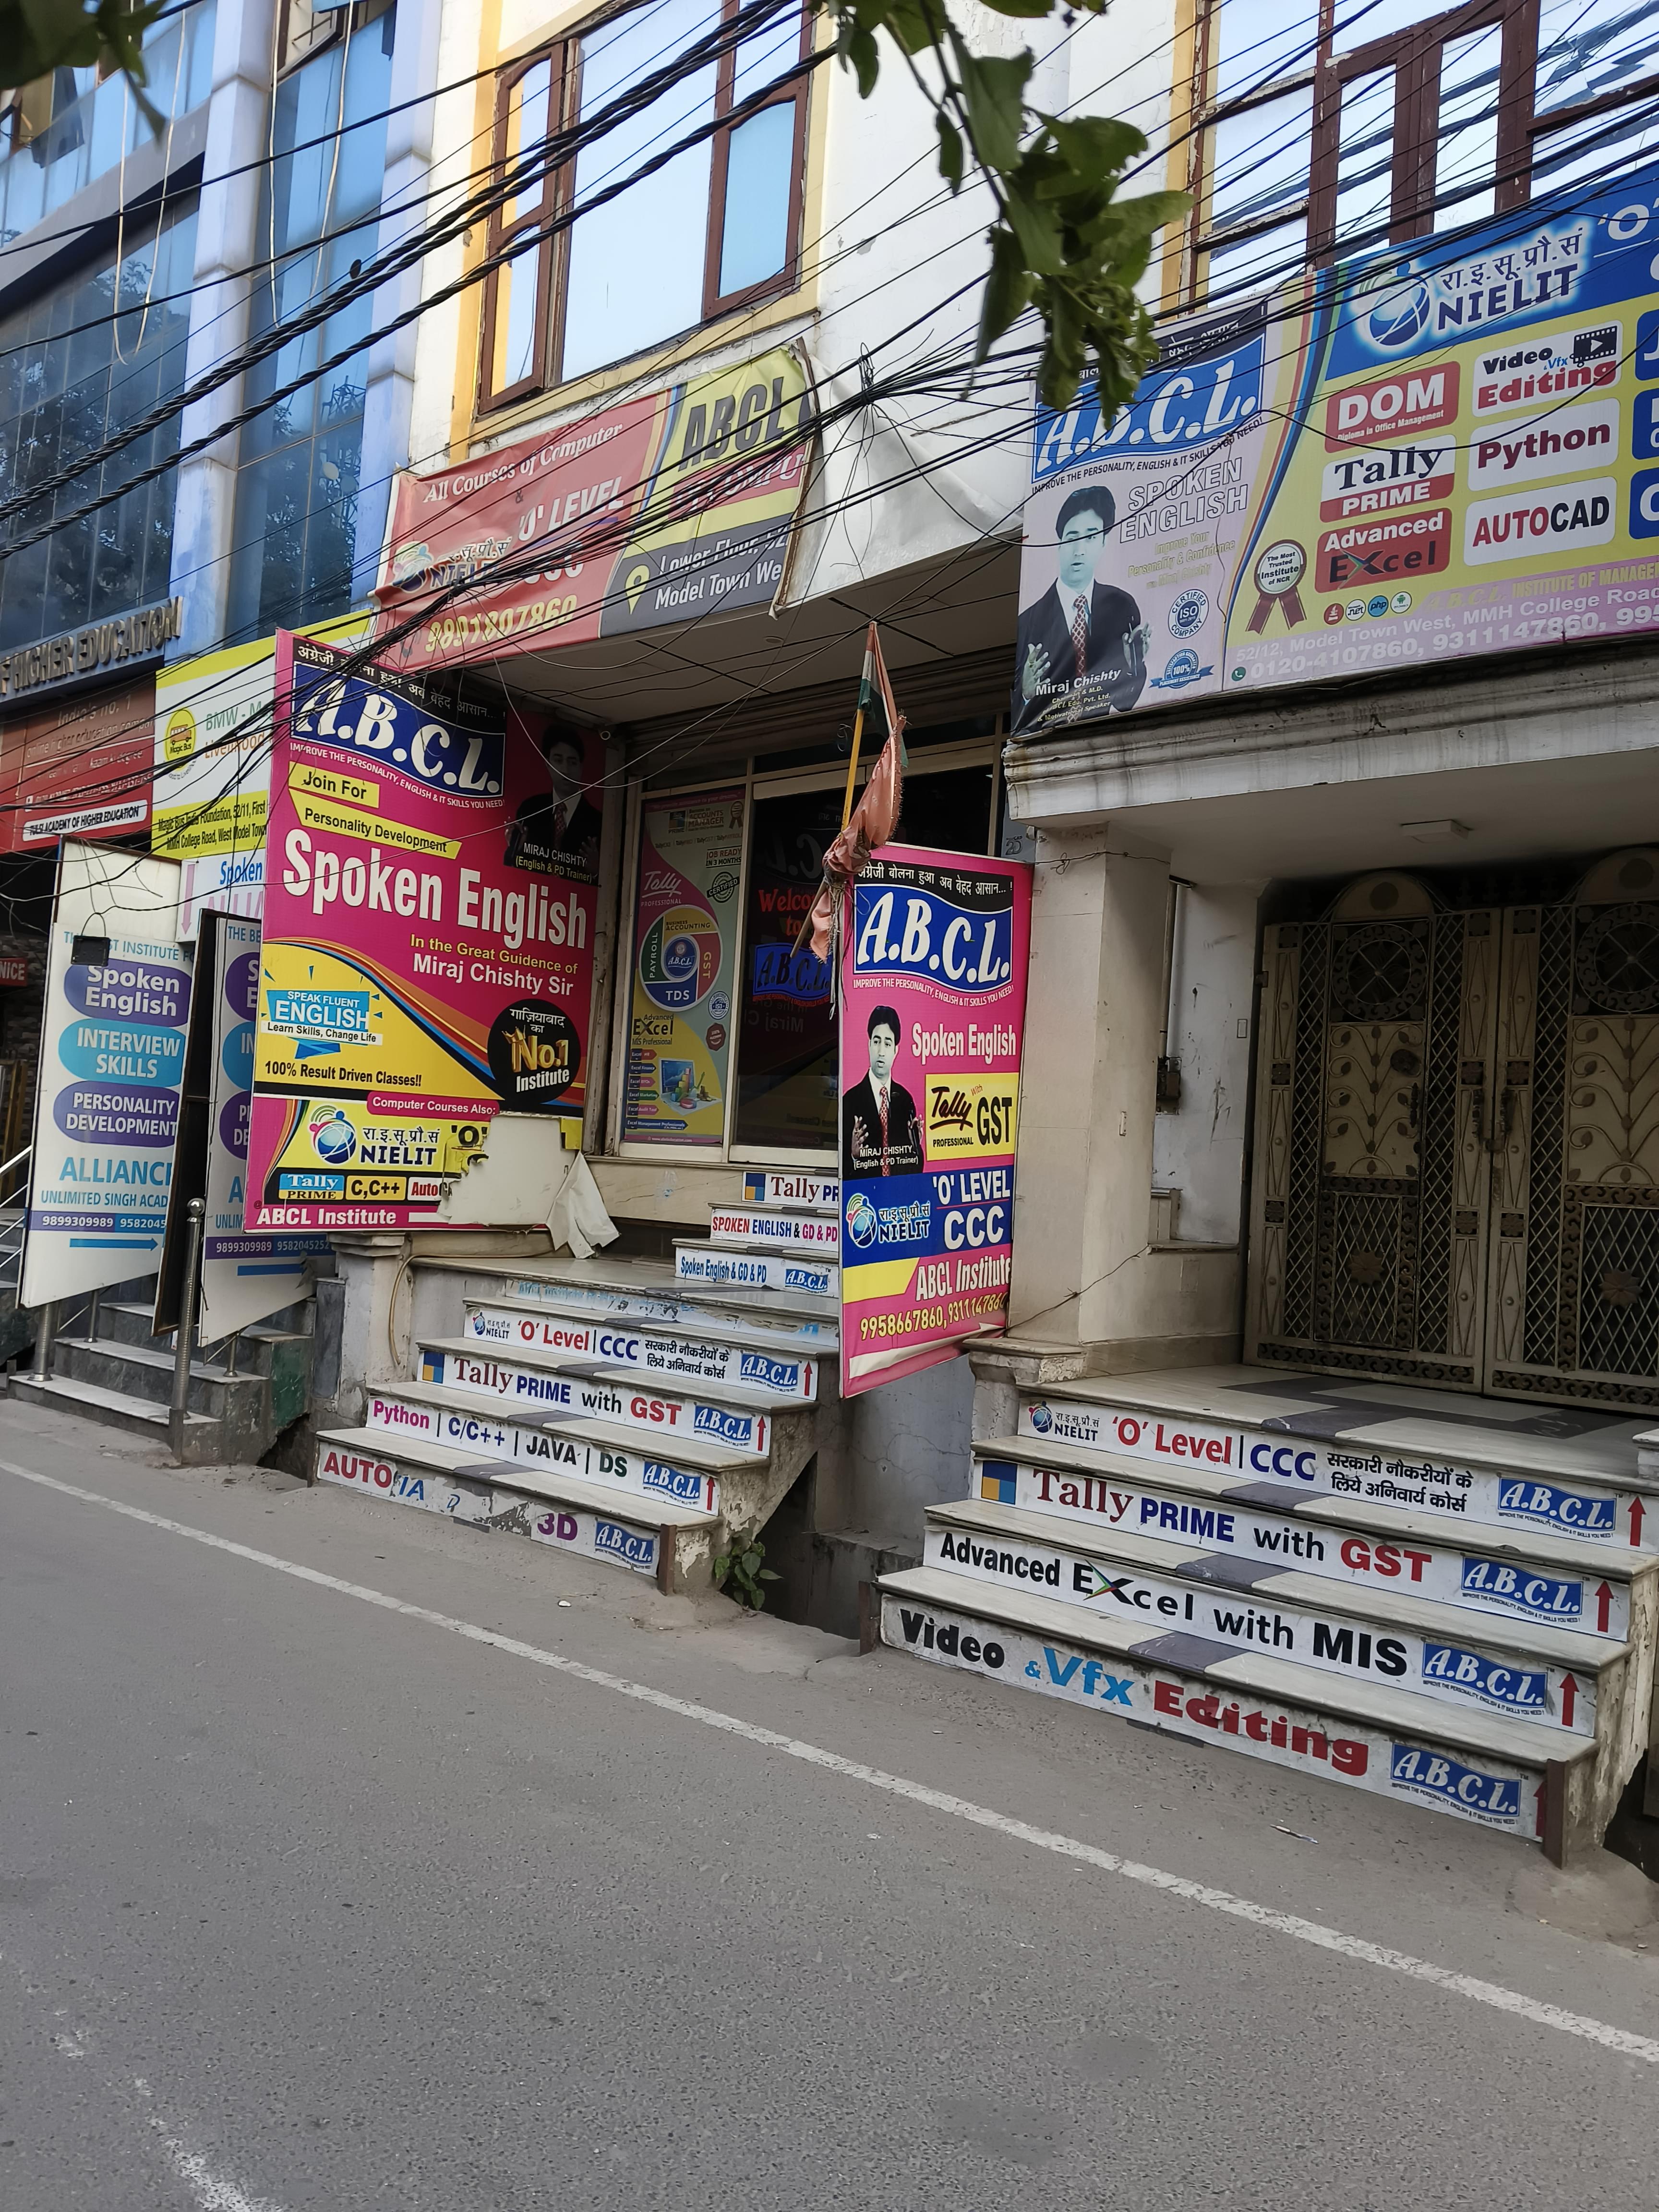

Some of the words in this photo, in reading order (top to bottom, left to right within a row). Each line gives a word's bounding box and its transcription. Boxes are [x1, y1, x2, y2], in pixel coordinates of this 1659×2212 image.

[1438, 264, 1577, 330] NIELIT
[1483, 347, 1553, 375] Video
[1478, 361, 1617, 410] Editing
[1338, 373, 1444, 430] DOM
[678, 376, 785, 472] ABCL
[1478, 423, 1610, 470] Python
[422, 481, 448, 503] All
[452, 461, 516, 495] Courses
[520, 457, 537, 476] of
[540, 421, 623, 466] Computer
[1334, 447, 1442, 490] Tally
[1129, 457, 1242, 511] SPOKEN
[1119, 483, 1248, 543] ENGLISH
[1343, 482, 1431, 516] PRIME
[1324, 512, 1443, 553] Advanced
[1472, 496, 1609, 547] AUTOCAD
[1261, 565, 1299, 579] Institute
[1269, 559, 1292, 568] Trusted
[654, 581, 704, 611] Model
[709, 569, 750, 597] Town
[1180, 605, 1197, 618] ISO
[1370, 601, 1386, 610] php
[11, 637, 74, 689] HIGHER
[76, 595, 183, 671] EDUCATION
[1236, 642, 1283, 662] 52/12,
[1290, 633, 1343, 653] Model
[1349, 625, 1397, 642] Town
[1404, 617, 1456, 633] West,
[1464, 604, 1512, 625] MMH
[1520, 596, 1599, 615] College
[1036, 680, 1069, 696] Miraj
[1074, 669, 1121, 688] Chishty
[341, 780, 367, 800] For
[44, 817, 71, 832] ACADEMY
[72, 817, 80, 828] OF
[80, 810, 103, 826] HIGHER
[104, 805, 139, 822] EDUCATION
[252, 800, 265, 816] First
[181, 832, 200, 849] College
[202, 830, 216, 845] Road,
[218, 827, 232, 839] West
[252, 824, 266, 836] Town
[304, 807, 373, 838] Personality
[374, 822, 447, 854] Development
[523, 842, 549, 858] MIRAJ
[220, 857, 262, 890] Spoken
[645, 870, 682, 897] Tally
[709, 878, 738, 896] CERTIFIED
[282, 828, 443, 922] Spoken
[457, 867, 588, 950] English
[641, 898, 682, 907] PROFESSIONAL
[665, 923, 711, 931] ACCOUNTING
[857, 891, 1010, 983] A.B.C.L.
[410, 935, 424, 948] In
[429, 939, 452, 952] the
[457, 943, 495, 960] Great
[499, 950, 561, 971] Guidence
[565, 963, 578, 974] of
[649, 933, 658, 978] PAYROLL
[703, 952, 711, 978] GST
[413, 953, 464, 983] Miraj
[470, 963, 543, 995] Chishty
[548, 976, 574, 996] Sir
[85, 986, 177, 1016] English
[288, 990, 321, 1003] SPEAK
[323, 996, 360, 1008] FLUENT
[665, 990, 689, 1001] TDS
[275, 999, 369, 1030] ENGLISH
[530, 1023, 545, 1034] का
[77, 1027, 180, 1057] INTERVIEW
[267, 1022, 294, 1033] Learn
[296, 1025, 323, 1037] Skills,
[325, 1029, 359, 1041] Change
[361, 1033, 376, 1042] Life
[912, 1022, 964, 1065] Spoken
[968, 1024, 1017, 1064] English
[96, 1054, 158, 1079] SKILLS
[265, 1060, 297, 1076] 100%
[300, 1064, 336, 1080] Result
[339, 1069, 373, 1083] Driven
[376, 1070, 422, 1087] Classes!!
[516, 1069, 570, 1093] Institute
[73, 1092, 175, 1116] PERSONALITY
[372, 1096, 424, 1110] Computer
[427, 1101, 468, 1114] Courses
[471, 1102, 496, 1115] Also:
[65, 1113, 178, 1136] DEVELOPMENT
[361, 1145, 437, 1165] NIELIT
[860, 1146, 881, 1157] MIRAJ
[883, 1145, 913, 1155] CHISHTY
[933, 1137, 974, 1147] PROFESSIONAL
[287, 1174, 339, 1190] Tally
[288, 1190, 337, 1200] PRIME
[960, 1170, 1010, 1202] LEVEL
[41, 1190, 101, 1205] UNLIMITED
[104, 1193, 136, 1207] SINGH
[256, 1208, 312, 1225] ABCL
[317, 1209, 397, 1225] Institute
[712, 1216, 749, 1234] SPOKEN
[752, 1219, 792, 1238] ENGLISH
[793, 1223, 800, 1238] &
[802, 1224, 815, 1239] GD
[817, 1227, 823, 1241] &
[825, 1226, 838, 1242] PD
[944, 1205, 1004, 1250] CCC
[879, 1221, 930, 1242] NIELIT
[216, 1241, 272, 1253] 9899309989
[915, 1261, 952, 1301] ABCL
[645, 1340, 677, 1354] सरकारी
[719, 1348, 730, 1363] के
[647, 1353, 665, 1369] लिये
[666, 1358, 702, 1374] अनिवार्य
[704, 1364, 725, 1379] कोर्स
[742, 1356, 797, 1385] A.B.C.L.
[454, 1357, 514, 1394] Tally
[516, 1375, 572, 1404] PRIME
[581, 1391, 622, 1414] with
[630, 1396, 682, 1425] GST
[694, 1407, 751, 1440] A.B.C.L.
[373, 1400, 430, 1429] Python
[448, 1417, 505, 1447] C/C++
[526, 1435, 577, 1466] JAVA
[599, 1453, 627, 1478] DS
[643, 1465, 701, 1499] A.B.C.L.
[1055, 1424, 1099, 1441] NIELIT
[1155, 1423, 1233, 1465] Level
[1249, 1443, 1317, 1481] CCC
[1327, 1452, 1383, 1474] सरकारी
[1386, 1458, 1454, 1485] नौकरीयों
[1455, 1470, 1474, 1489] के
[1331, 1471, 1362, 1493] लिये
[1365, 1479, 1427, 1504] अनिवार्य
[1430, 1491, 1467, 1512] कोर्स
[1033, 1468, 1134, 1523] Tally
[1141, 1497, 1236, 1544] PRIME
[1252, 1525, 1324, 1562] with
[1340, 1538, 1432, 1583] GST
[1465, 1563, 1579, 1612] A.B.C.L.
[940, 1531, 1060, 1587] Advanced
[1214, 1608, 1294, 1650] with
[1312, 1622, 1408, 1677] MIS
[1423, 1647, 1545, 1706] A.B.C.L.
[900, 1609, 1005, 1669] Video
[1153, 1680, 1369, 1777] Editing
